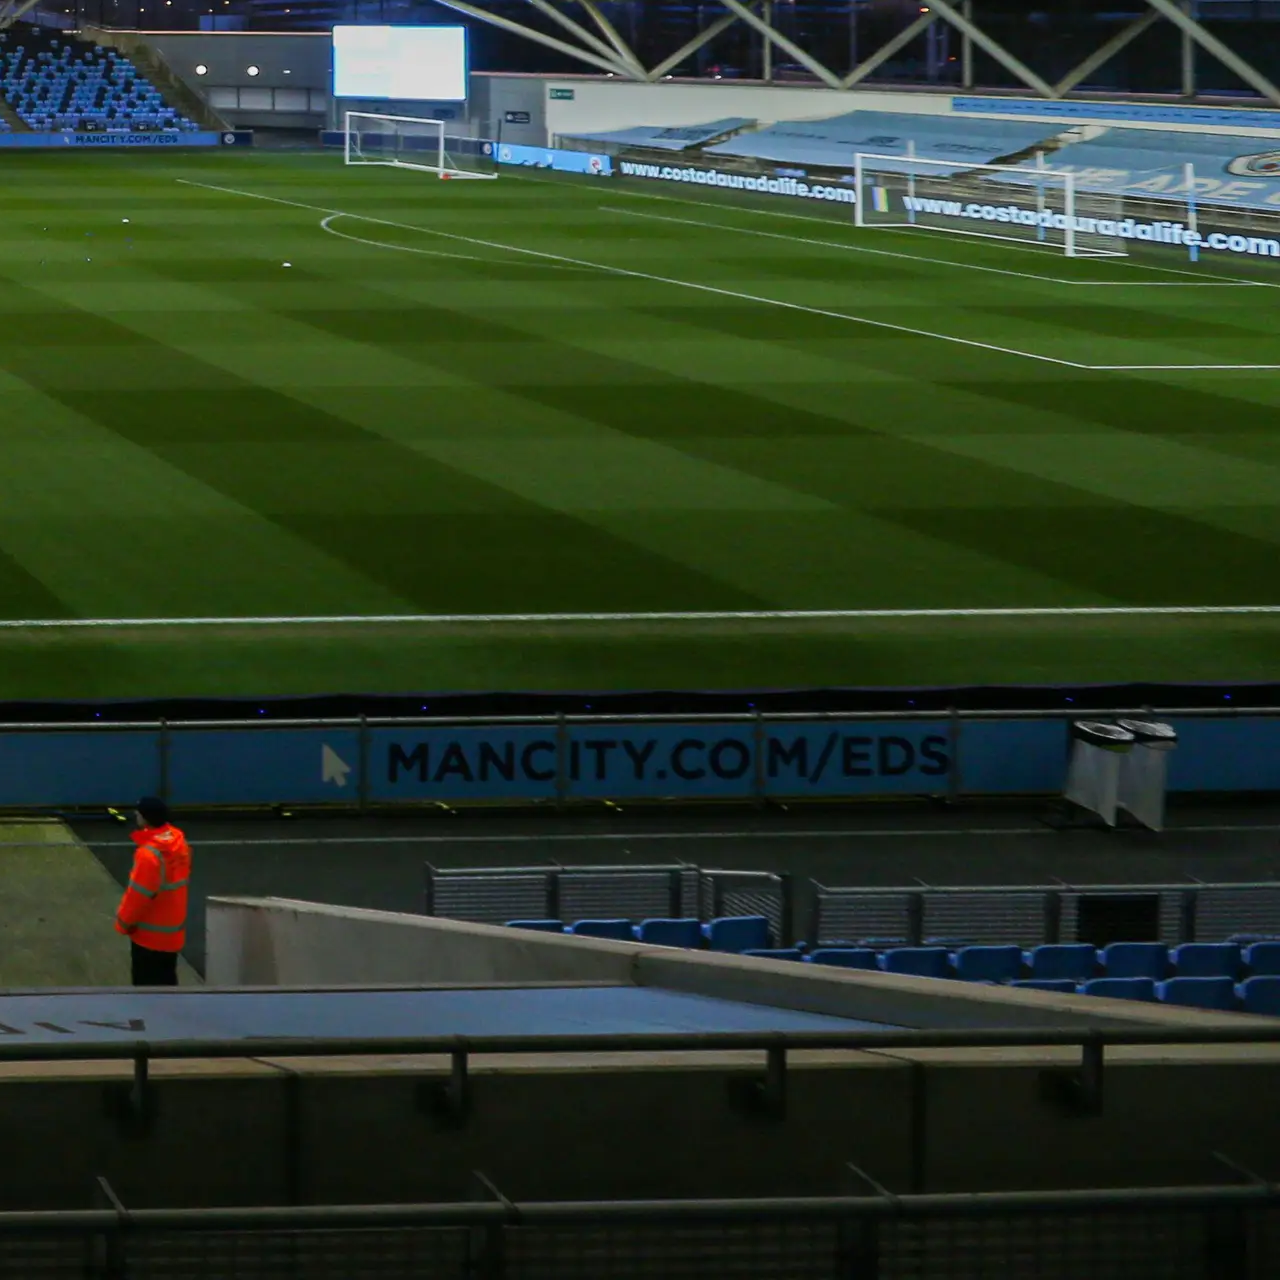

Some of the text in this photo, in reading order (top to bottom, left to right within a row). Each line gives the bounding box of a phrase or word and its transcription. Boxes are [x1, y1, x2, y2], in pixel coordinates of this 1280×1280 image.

[75, 135, 178, 144] MANCITY.COM/EDS
[621, 161, 856, 204] www.costadauradalife.com
[903, 195, 1280, 256] www.costadauradalife.com
[388, 732, 951, 782] MANCITY.COM/EDS
